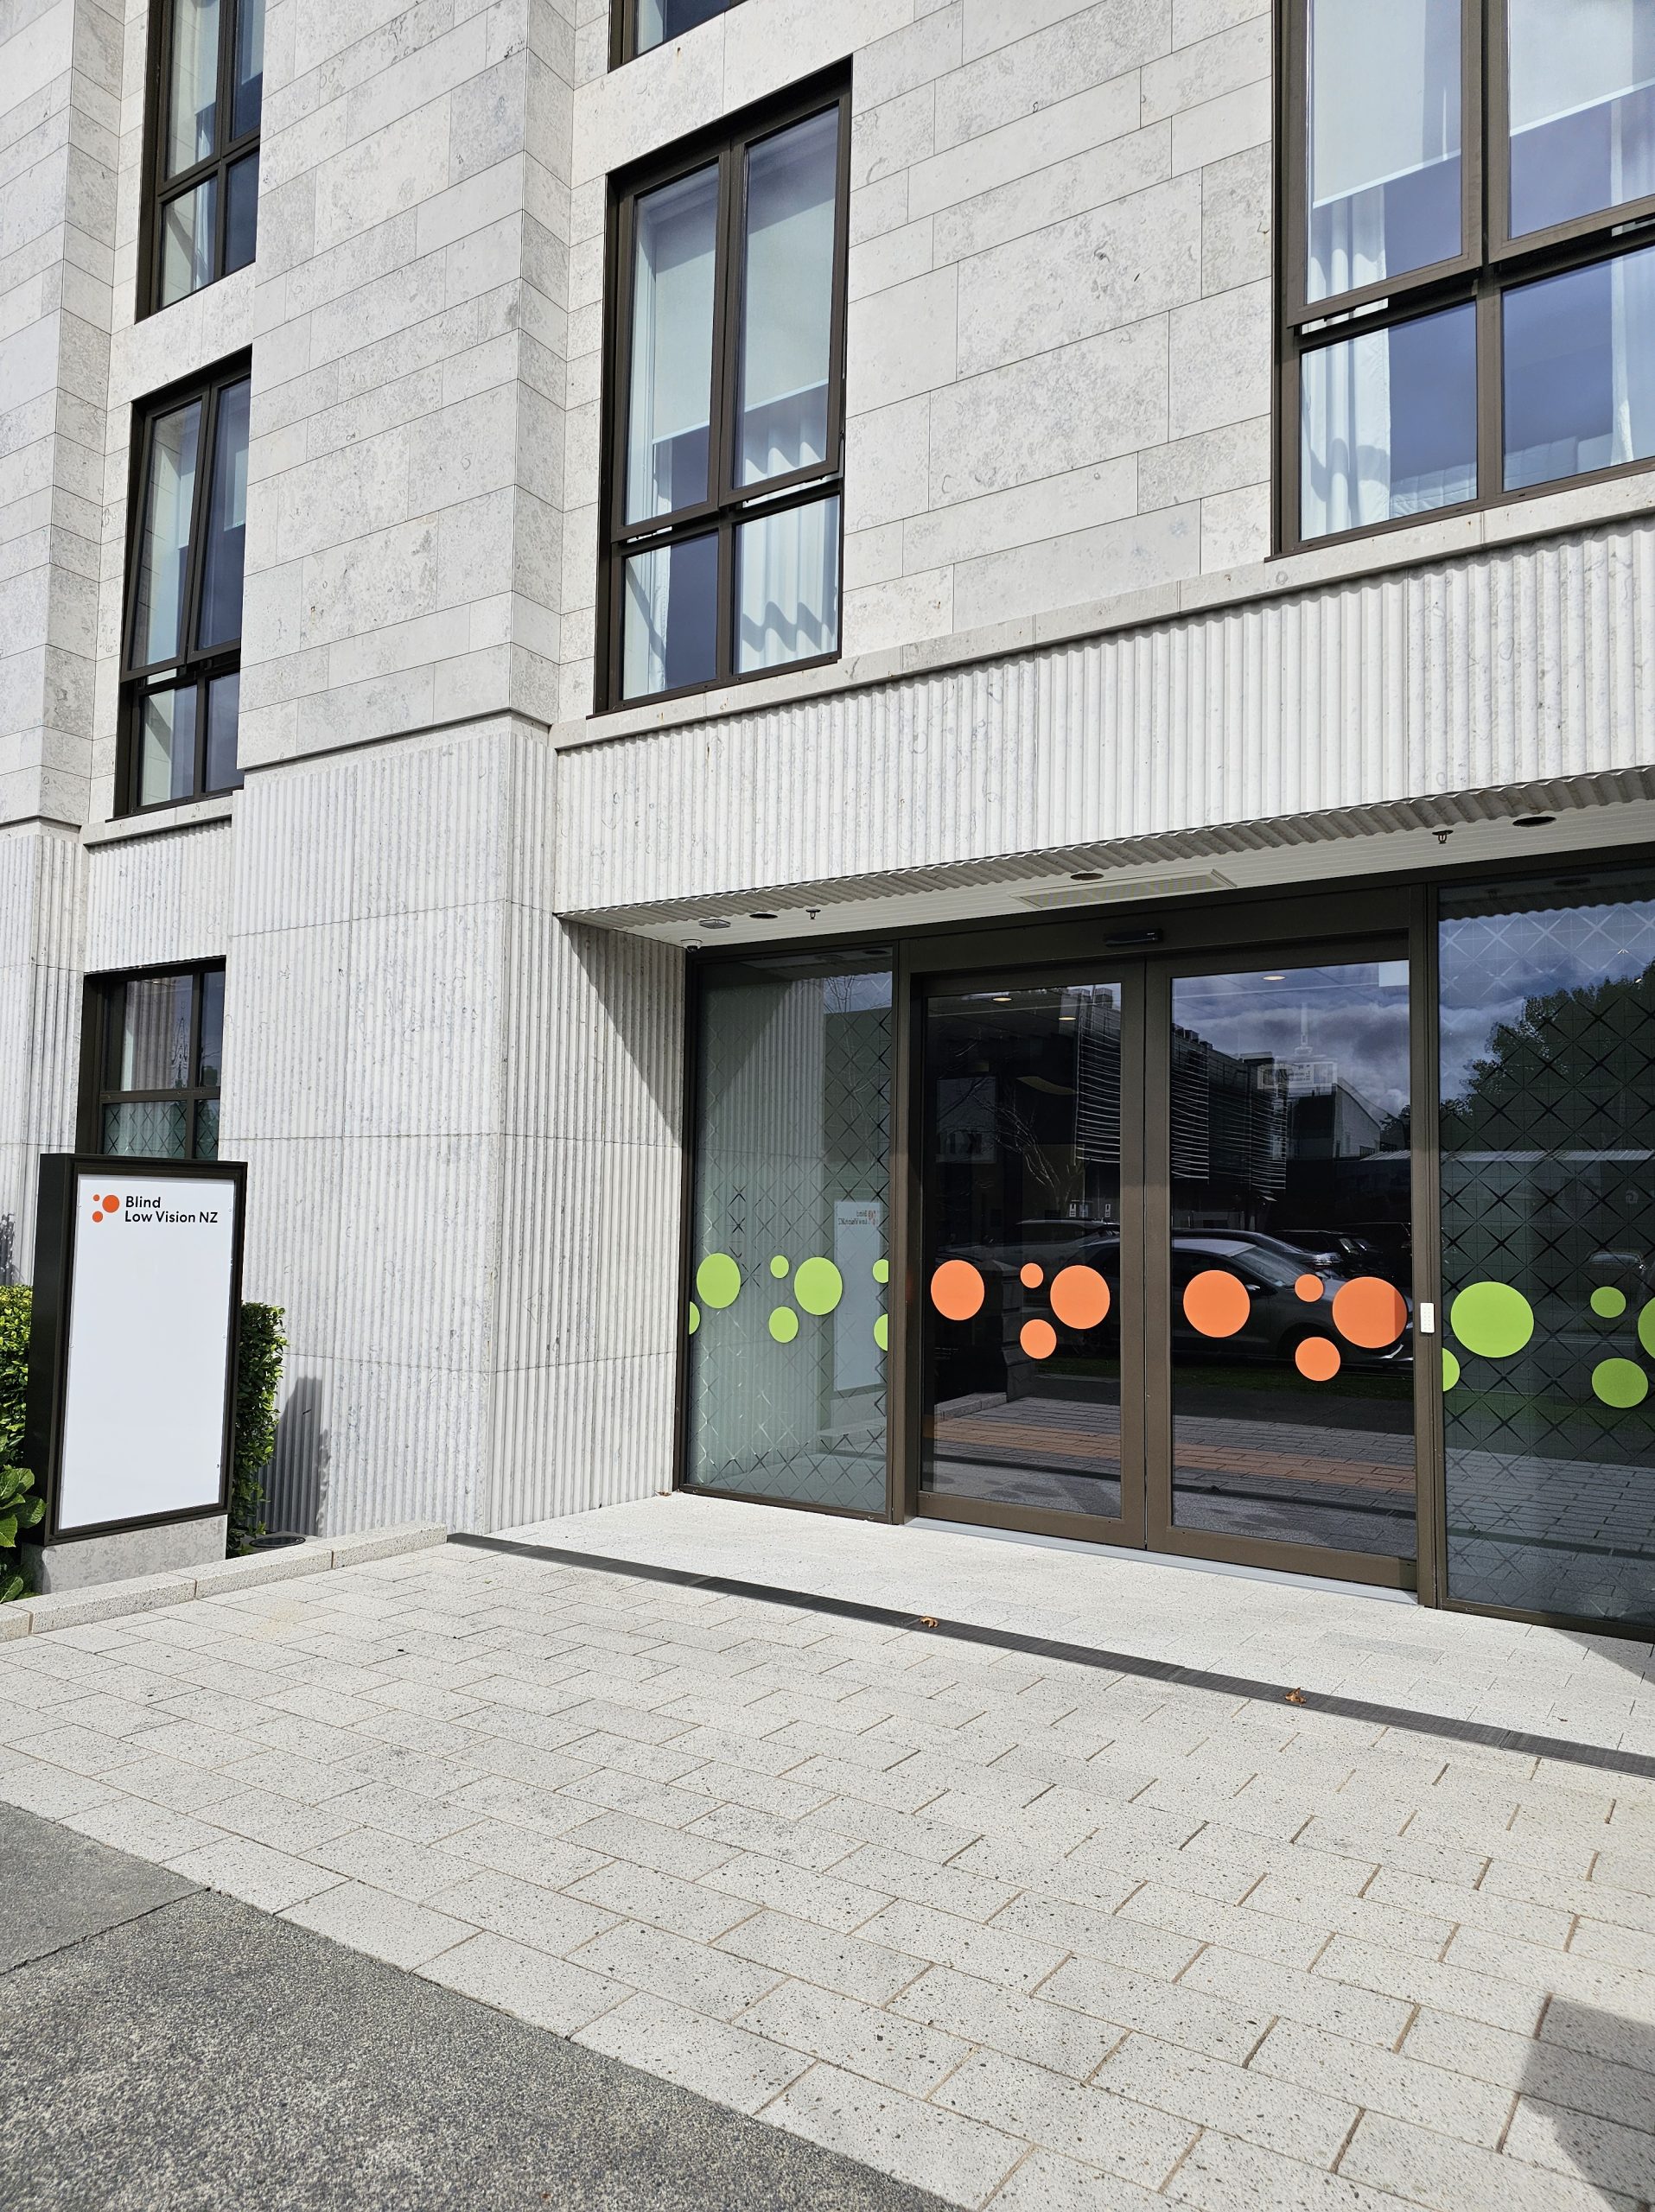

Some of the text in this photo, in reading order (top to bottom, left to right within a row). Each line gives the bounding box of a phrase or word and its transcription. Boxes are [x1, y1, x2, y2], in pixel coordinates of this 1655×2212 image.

[125, 1195, 162, 1209] Blind
[124, 1210, 219, 1224] Low Vision NZ
